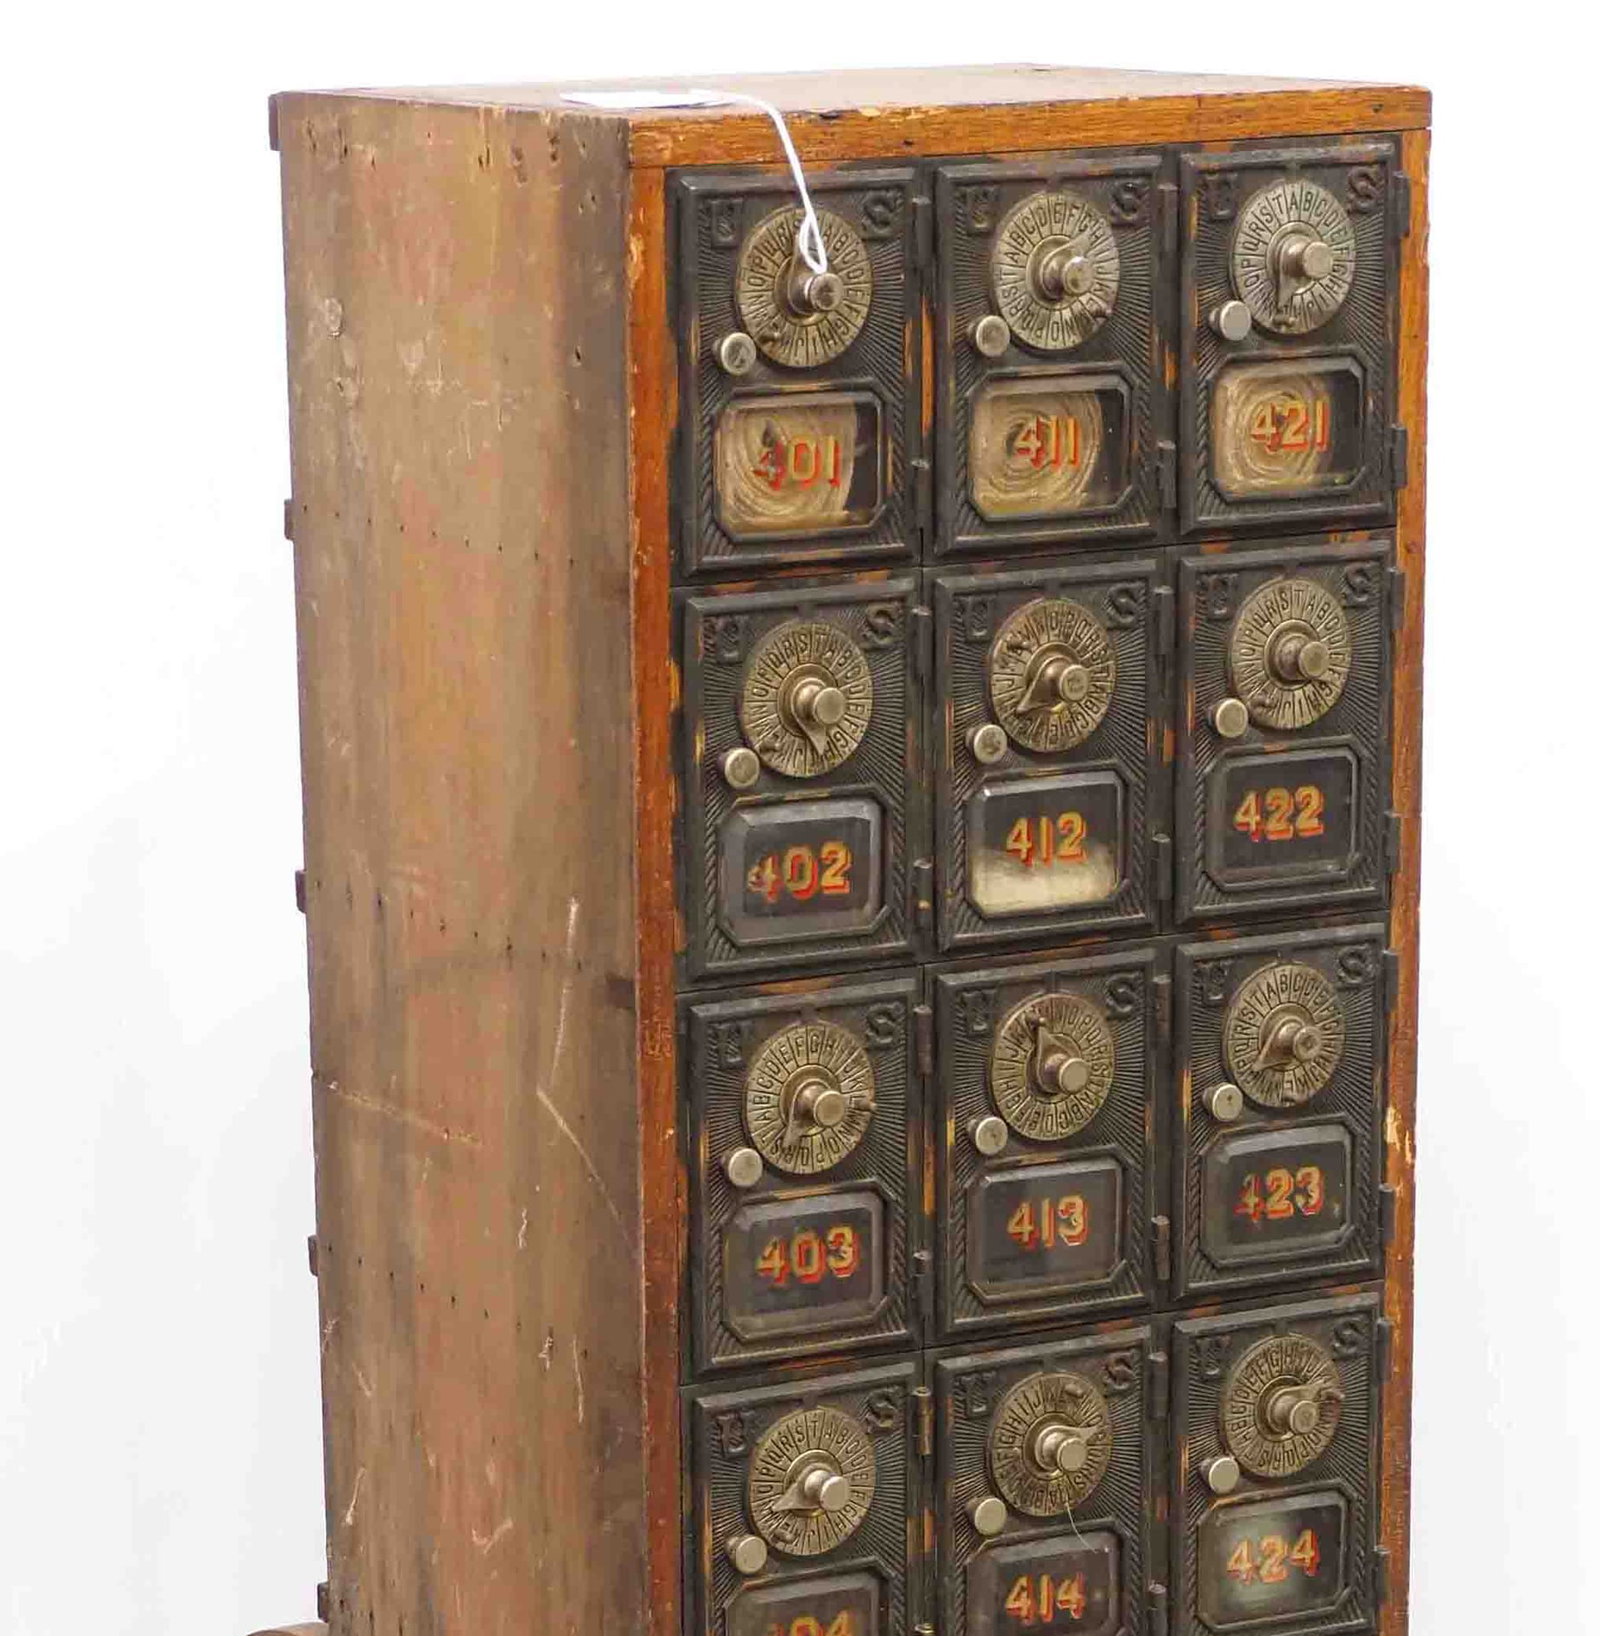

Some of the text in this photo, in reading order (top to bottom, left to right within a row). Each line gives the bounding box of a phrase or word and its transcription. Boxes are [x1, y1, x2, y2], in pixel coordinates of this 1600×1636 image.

[1016, 415, 1079, 471] 411
[1251, 401, 1330, 453] 421
[754, 435, 841, 491] 401
[1007, 811, 1087, 868] 412
[1233, 785, 1325, 842] 422
[747, 841, 853, 903] 402
[1006, 1195, 1088, 1251] 413
[1234, 1166, 1325, 1227] 423
[756, 1226, 861, 1287] 403
[1226, 1528, 1320, 1585] 424
[1005, 1571, 1086, 1625] 414
